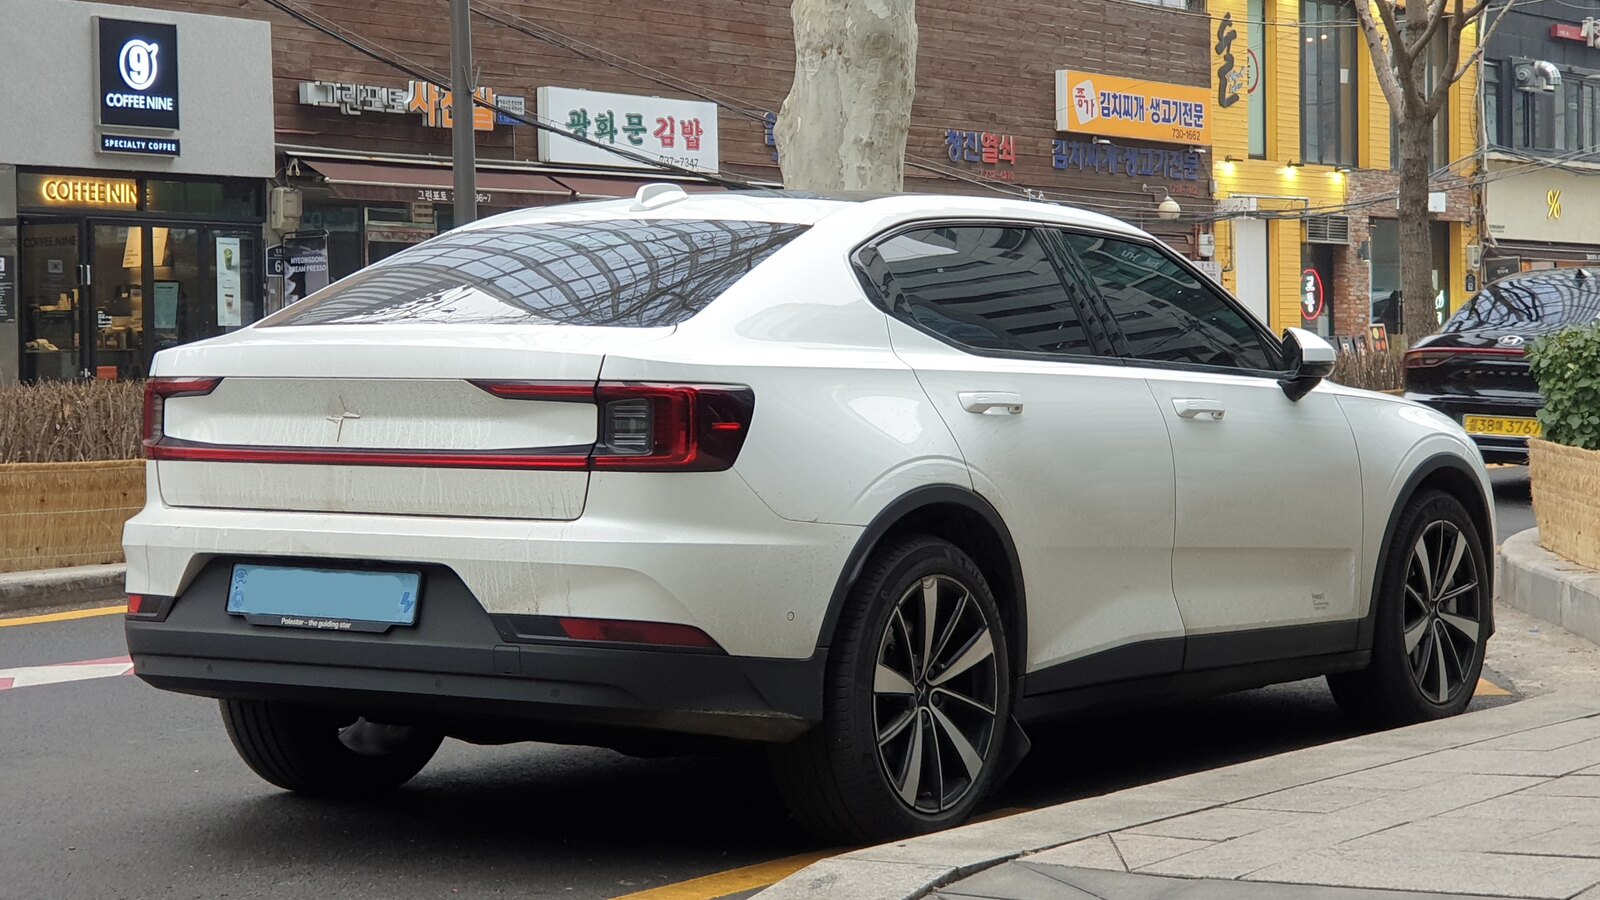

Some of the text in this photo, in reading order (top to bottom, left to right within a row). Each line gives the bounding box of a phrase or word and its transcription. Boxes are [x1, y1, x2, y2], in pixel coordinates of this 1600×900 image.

[106, 93, 173, 111] COFFEE NINE
[1074, 87, 1095, 119] 종가
[565, 108, 704, 152] 광화문 김밥
[1171, 128, 1201, 141] 730-1662
[104, 139, 176, 151] SPECIALTY COFFEE
[42, 180, 105, 202] COFFEE
[281, 617, 304, 626] Polestar
[318, 620, 339, 629] guiding
